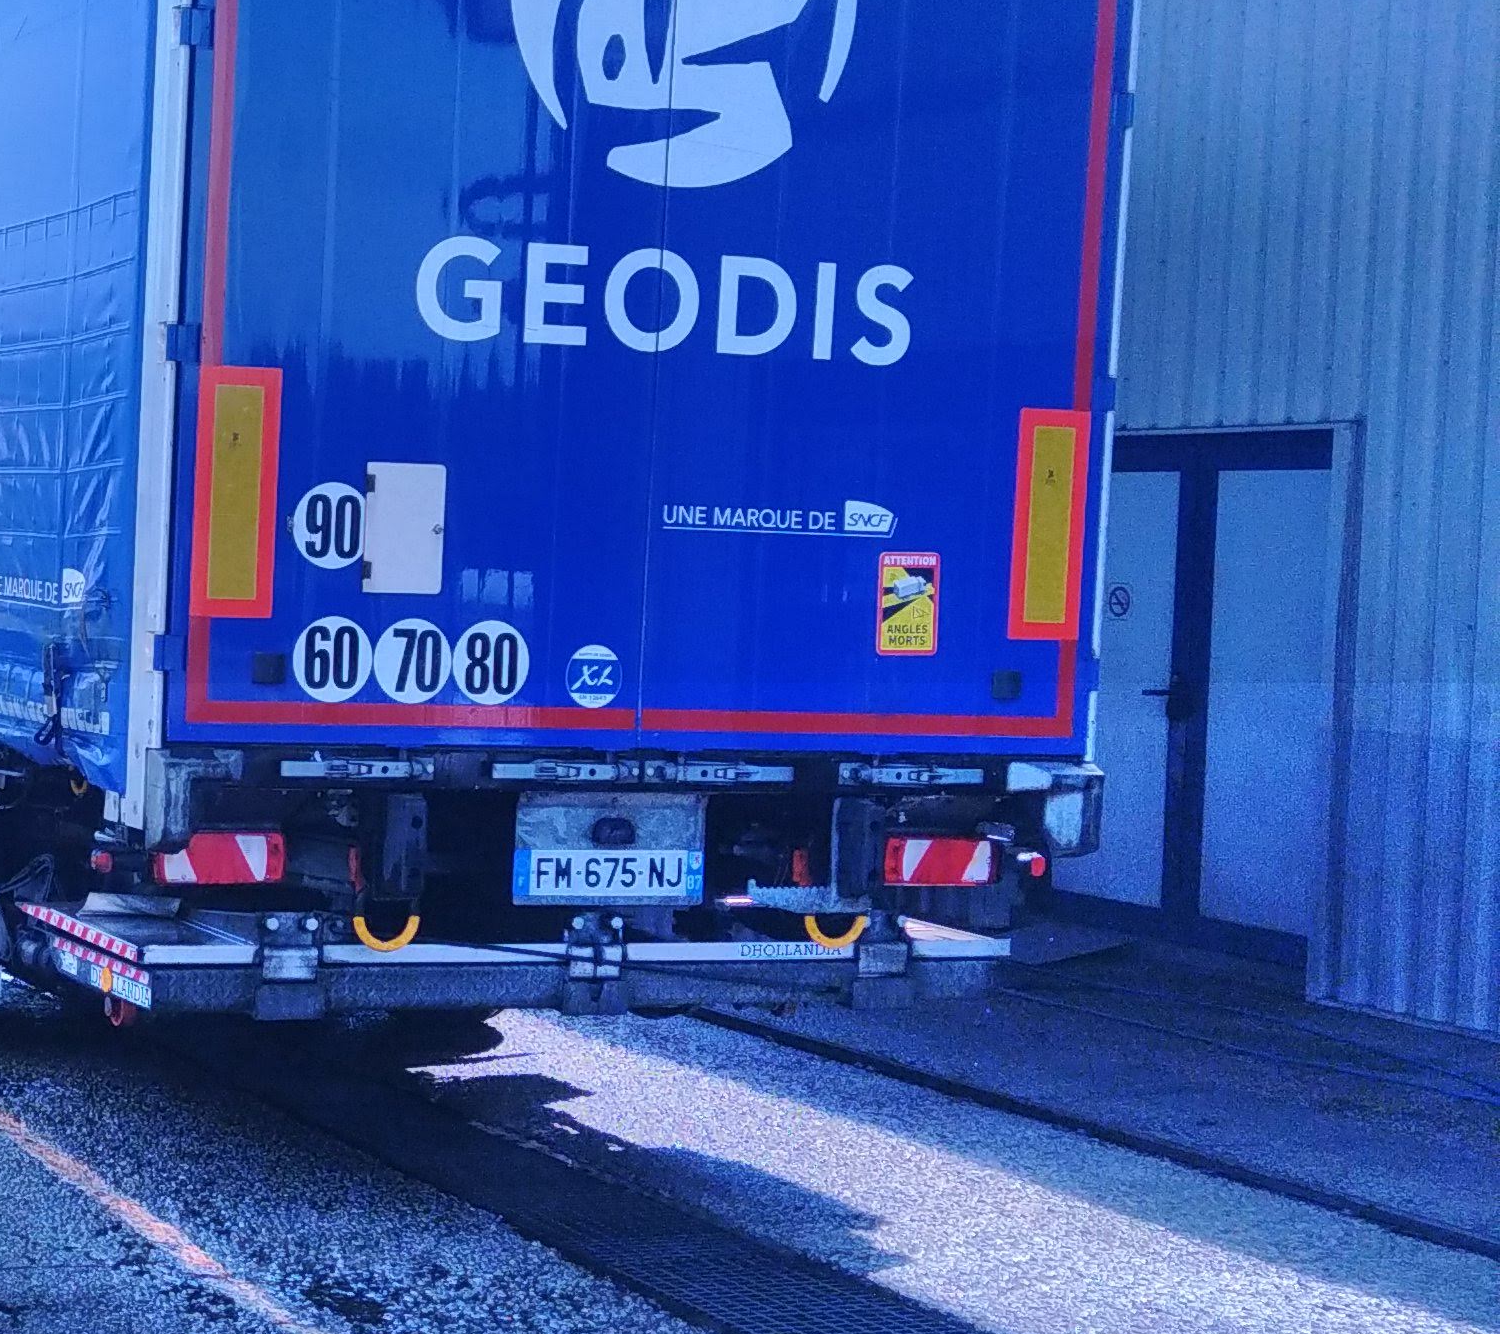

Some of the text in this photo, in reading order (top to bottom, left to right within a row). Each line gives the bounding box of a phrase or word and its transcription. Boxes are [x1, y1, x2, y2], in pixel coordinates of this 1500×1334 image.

[416, 235, 914, 366] GEODIS
[305, 494, 361, 559] 90
[663, 504, 891, 530] UNE MARQUE DE SNCF
[883, 555, 937, 566] ATTENTION
[4, 576, 43, 602] MARQUE
[44, 581, 59, 602] DE
[887, 624, 928, 635] ANGLES
[888, 636, 927, 646] MORTS
[304, 625, 360, 690] 60
[393, 628, 442, 693] 70
[465, 632, 518, 695] 80
[687, 874, 703, 890] 87
